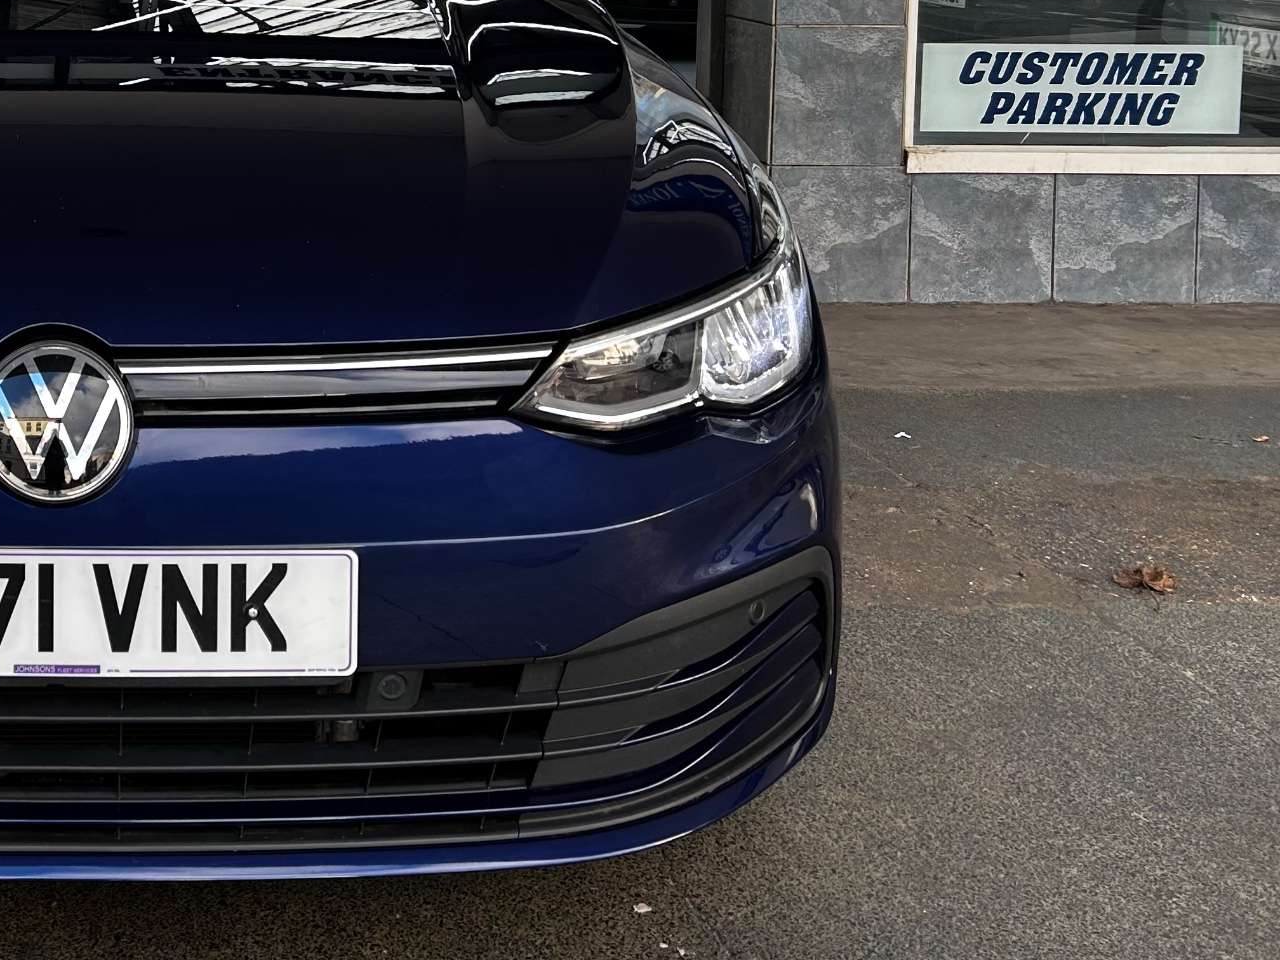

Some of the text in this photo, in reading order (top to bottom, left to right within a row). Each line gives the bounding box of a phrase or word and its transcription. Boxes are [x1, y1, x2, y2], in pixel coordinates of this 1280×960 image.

[1219, 26, 1278, 60] KY22 X
[959, 51, 1205, 86] CUSTOMER
[979, 91, 1180, 126] PARKING
[92, 562, 288, 653] VNK
[15, 665, 56, 673] JOHNSONS
